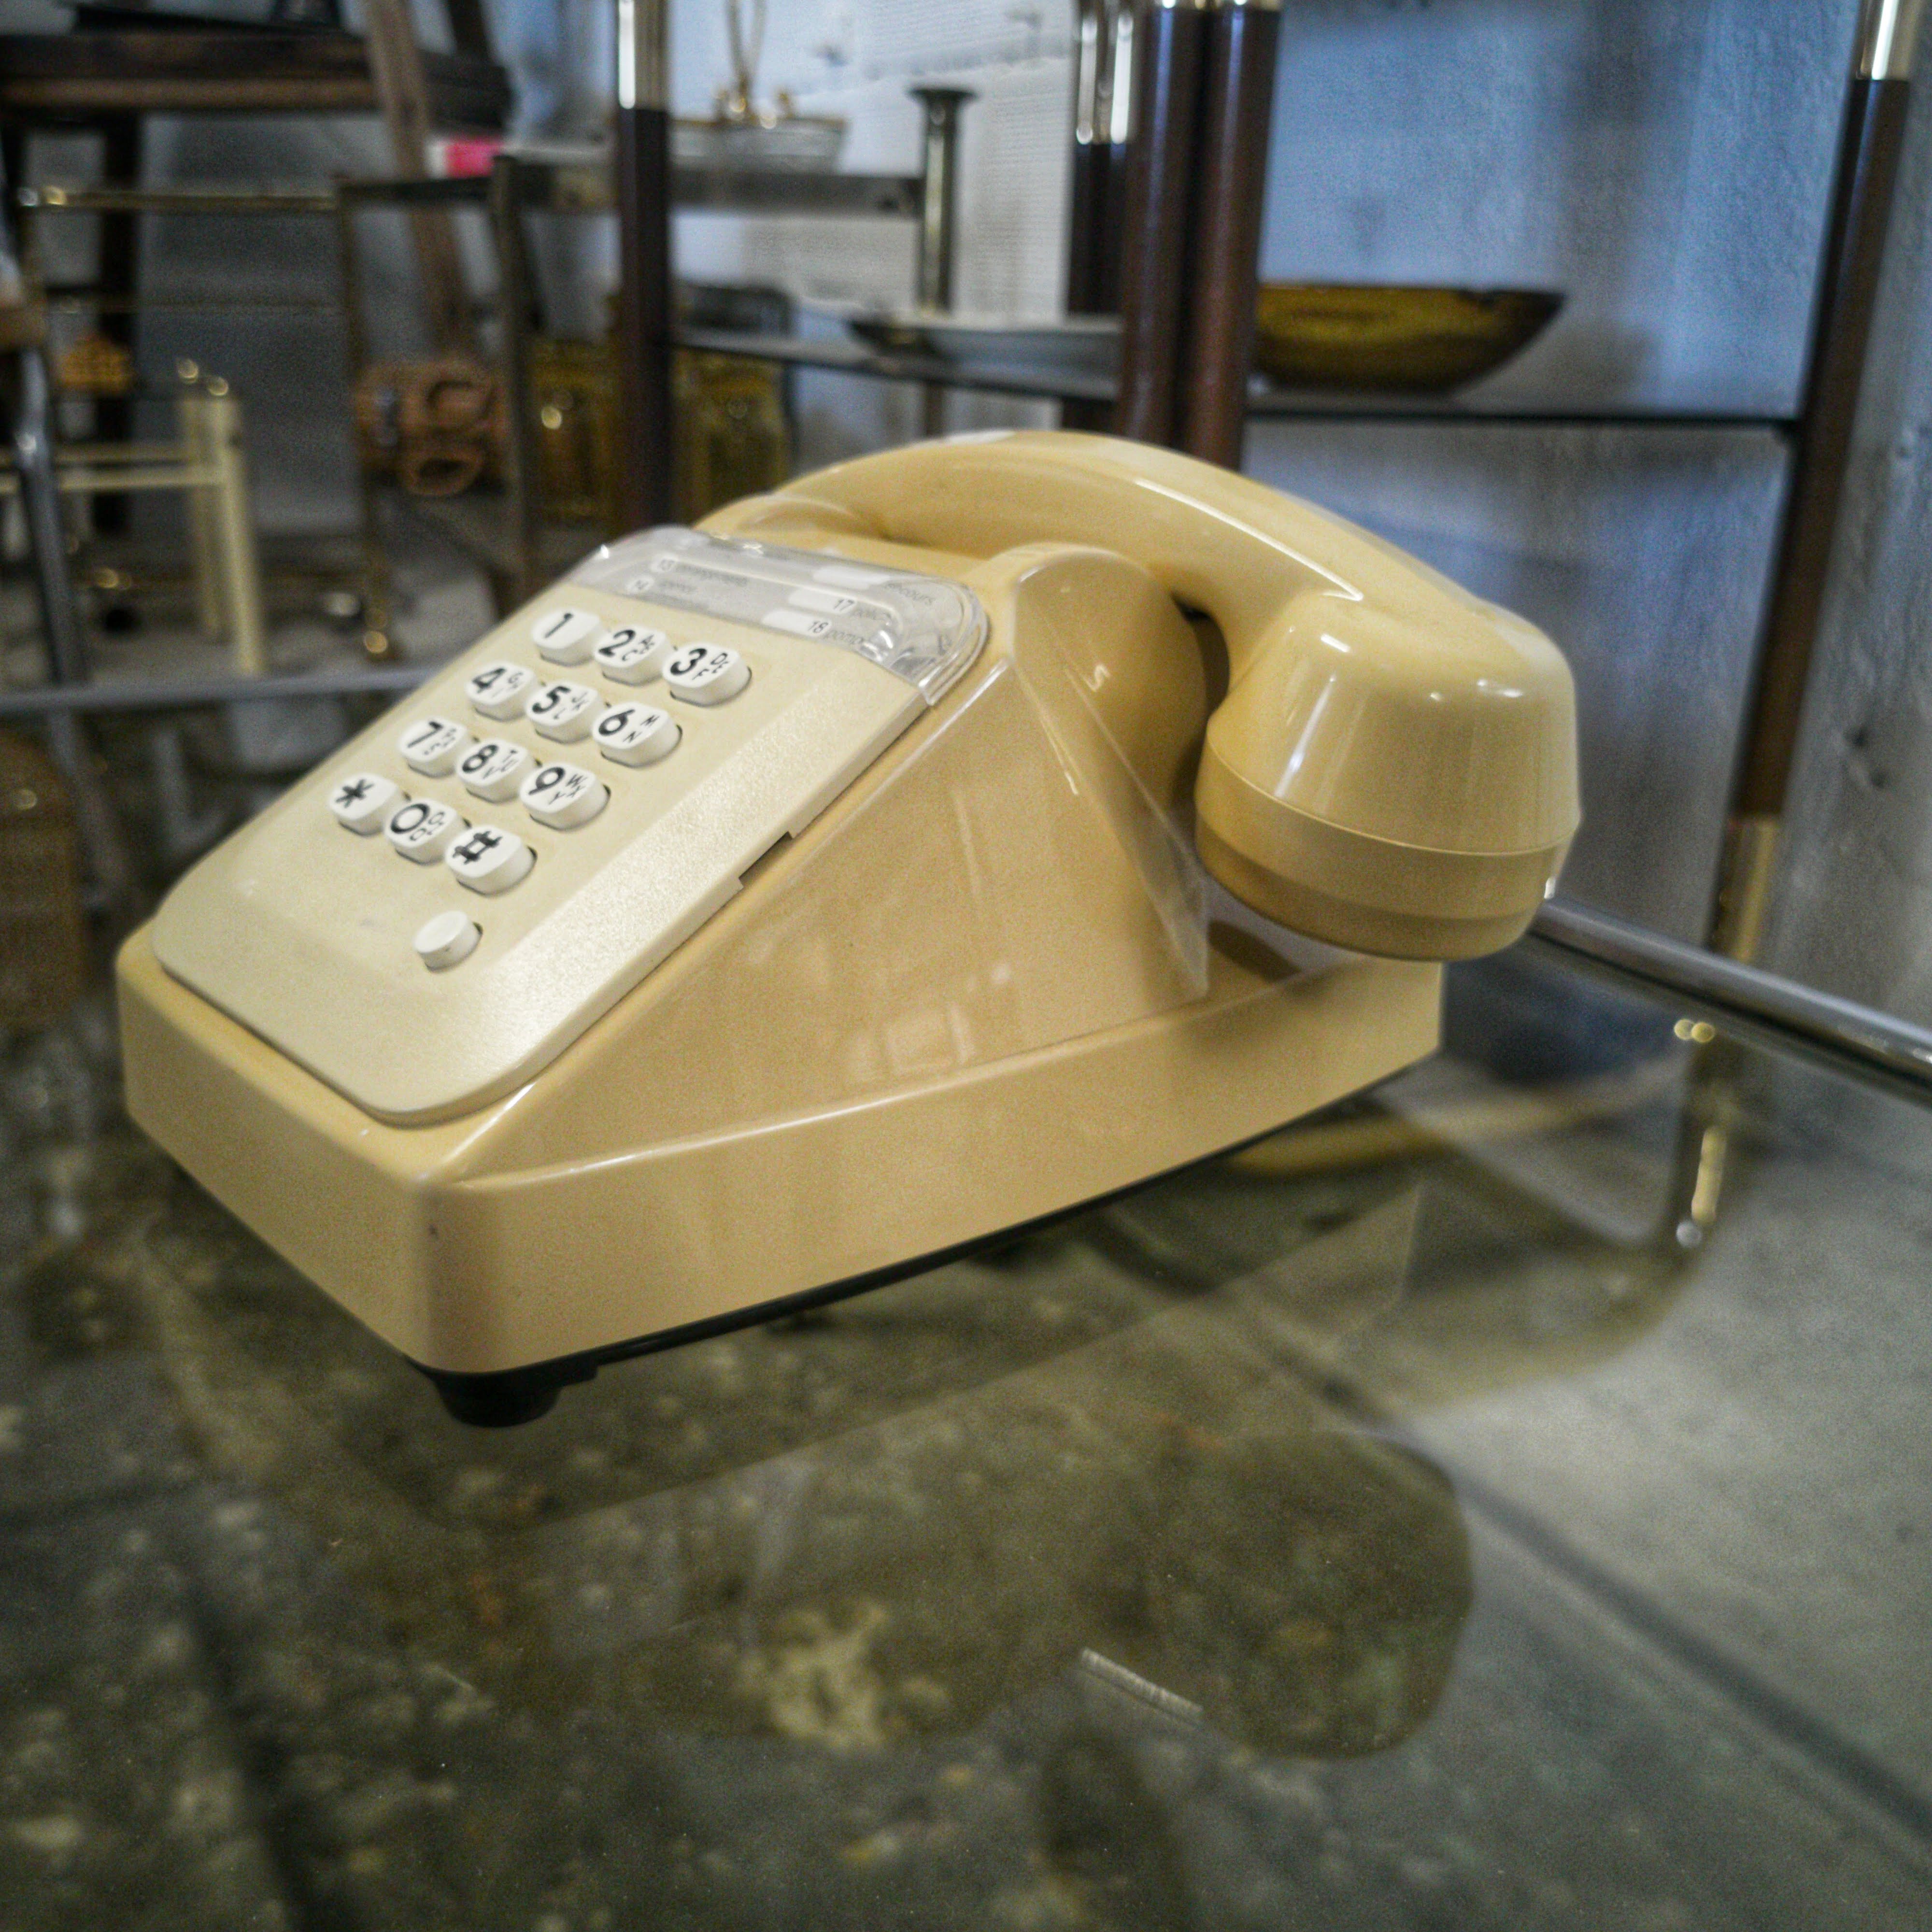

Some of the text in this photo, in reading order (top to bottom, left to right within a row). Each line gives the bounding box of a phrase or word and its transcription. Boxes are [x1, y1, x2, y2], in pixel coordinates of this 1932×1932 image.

[833, 599, 854, 611] 17
[544, 612, 573, 639] 1
[808, 621, 828, 634] 18
[598, 629, 637, 657] 2
[669, 648, 707, 676] 3
[471, 667, 506, 694] 4
[532, 685, 571, 714] 5
[407, 720, 444, 748] 7
[598, 709, 636, 736] 6
[461, 744, 499, 774] 8
[528, 766, 566, 796] 9
[390, 803, 431, 835] 0
